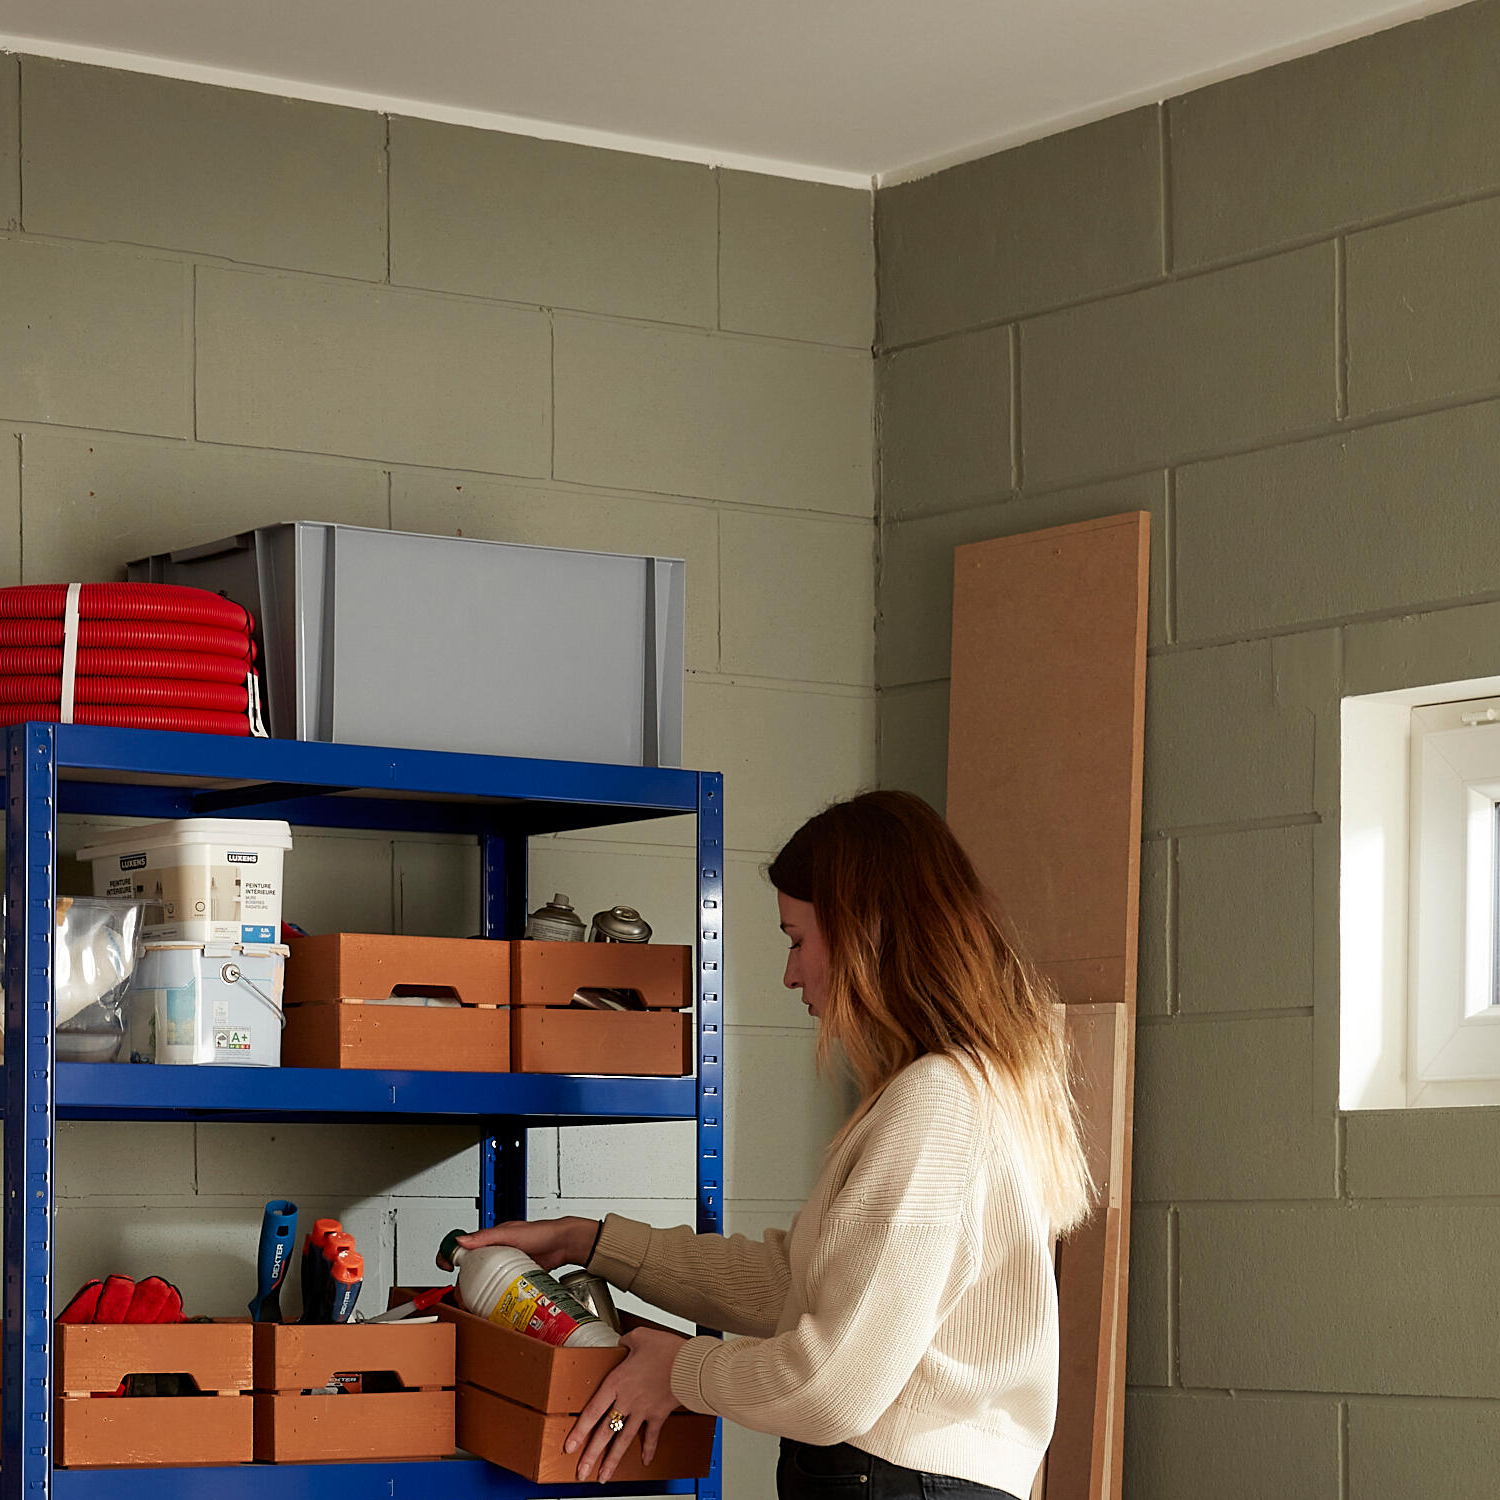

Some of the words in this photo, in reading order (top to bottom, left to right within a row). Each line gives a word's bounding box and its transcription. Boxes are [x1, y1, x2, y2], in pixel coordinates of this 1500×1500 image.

[121, 858, 146, 869] LUXENS
[228, 854, 257, 863] LUXENS
[231, 1032, 248, 1043] A+
[271, 1243, 284, 1279] DEXTER
[339, 1291, 351, 1315] DEXTER
